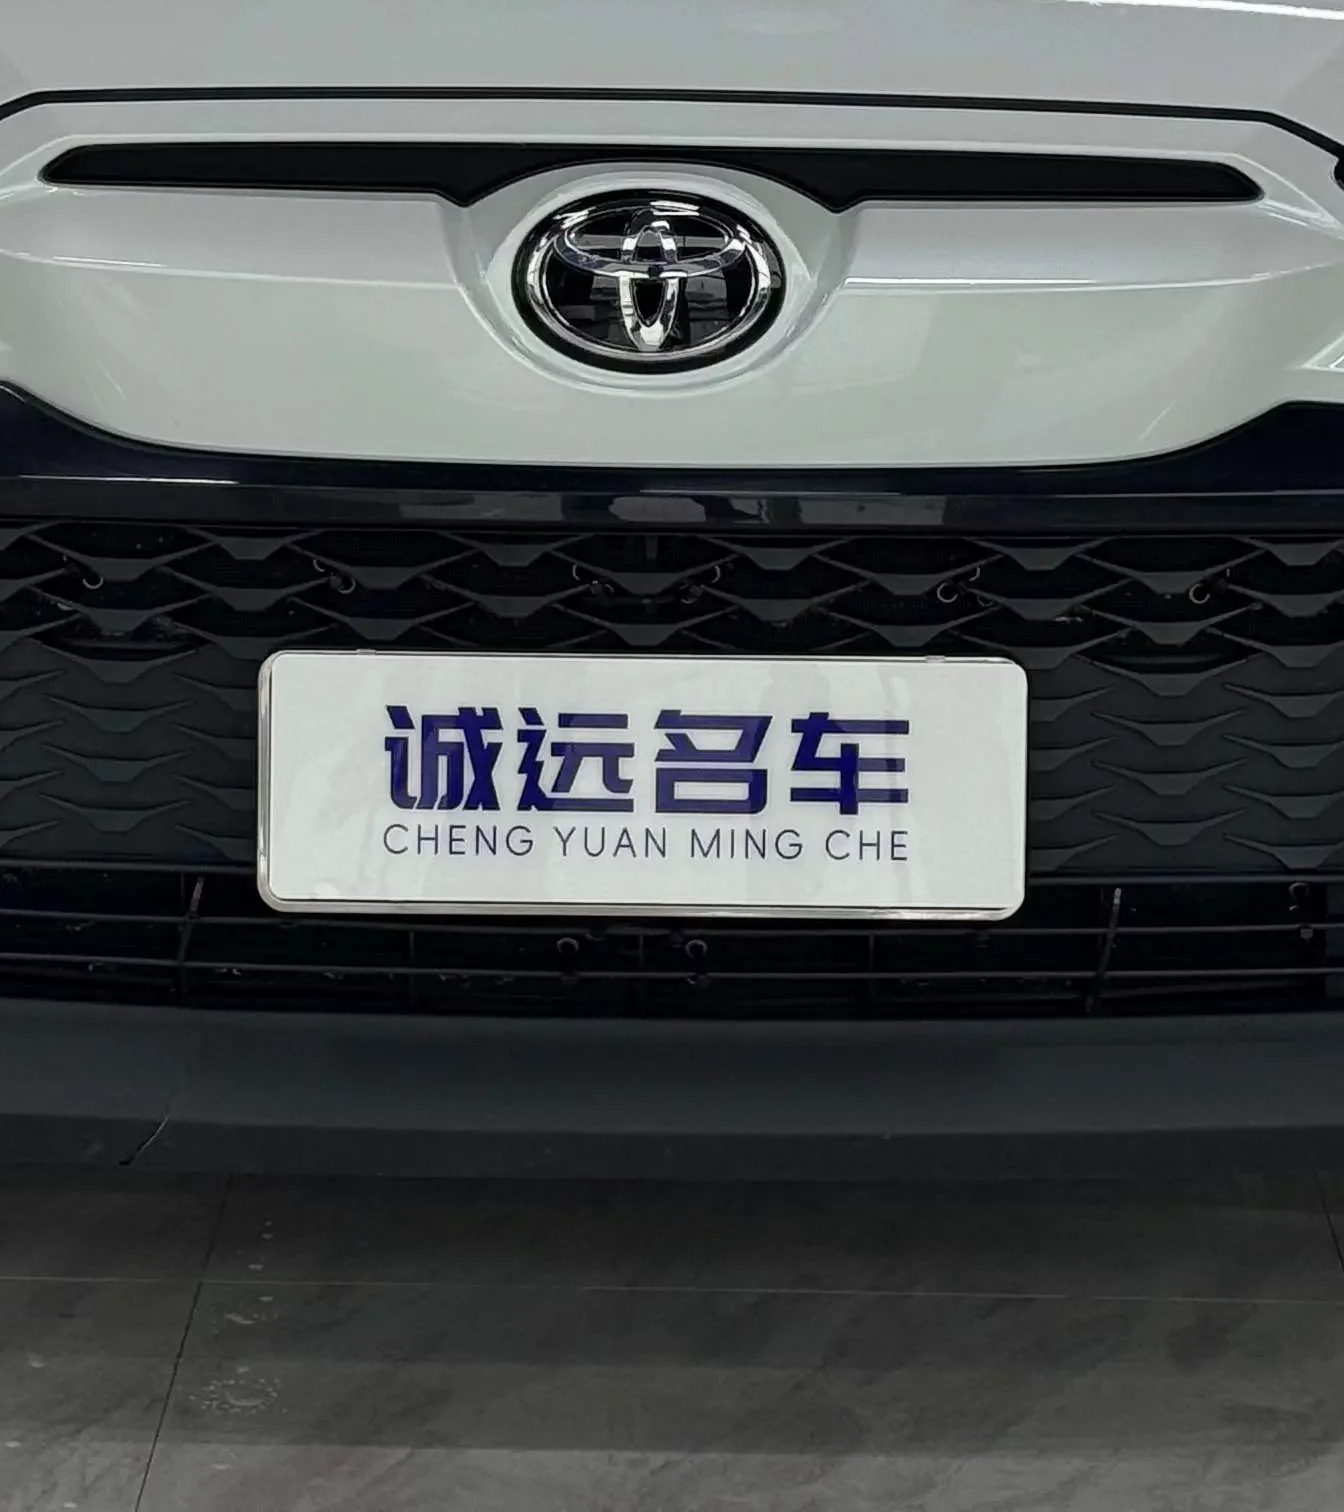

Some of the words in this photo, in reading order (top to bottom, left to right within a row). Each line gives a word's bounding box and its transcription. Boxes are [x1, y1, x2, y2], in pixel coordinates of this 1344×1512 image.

[384, 704, 910, 816] 诚远名车
[383, 823, 534, 857] CHENG
[553, 826, 666, 859] YUAN
[690, 828, 803, 861] MING
[825, 829, 908, 862] CHE
